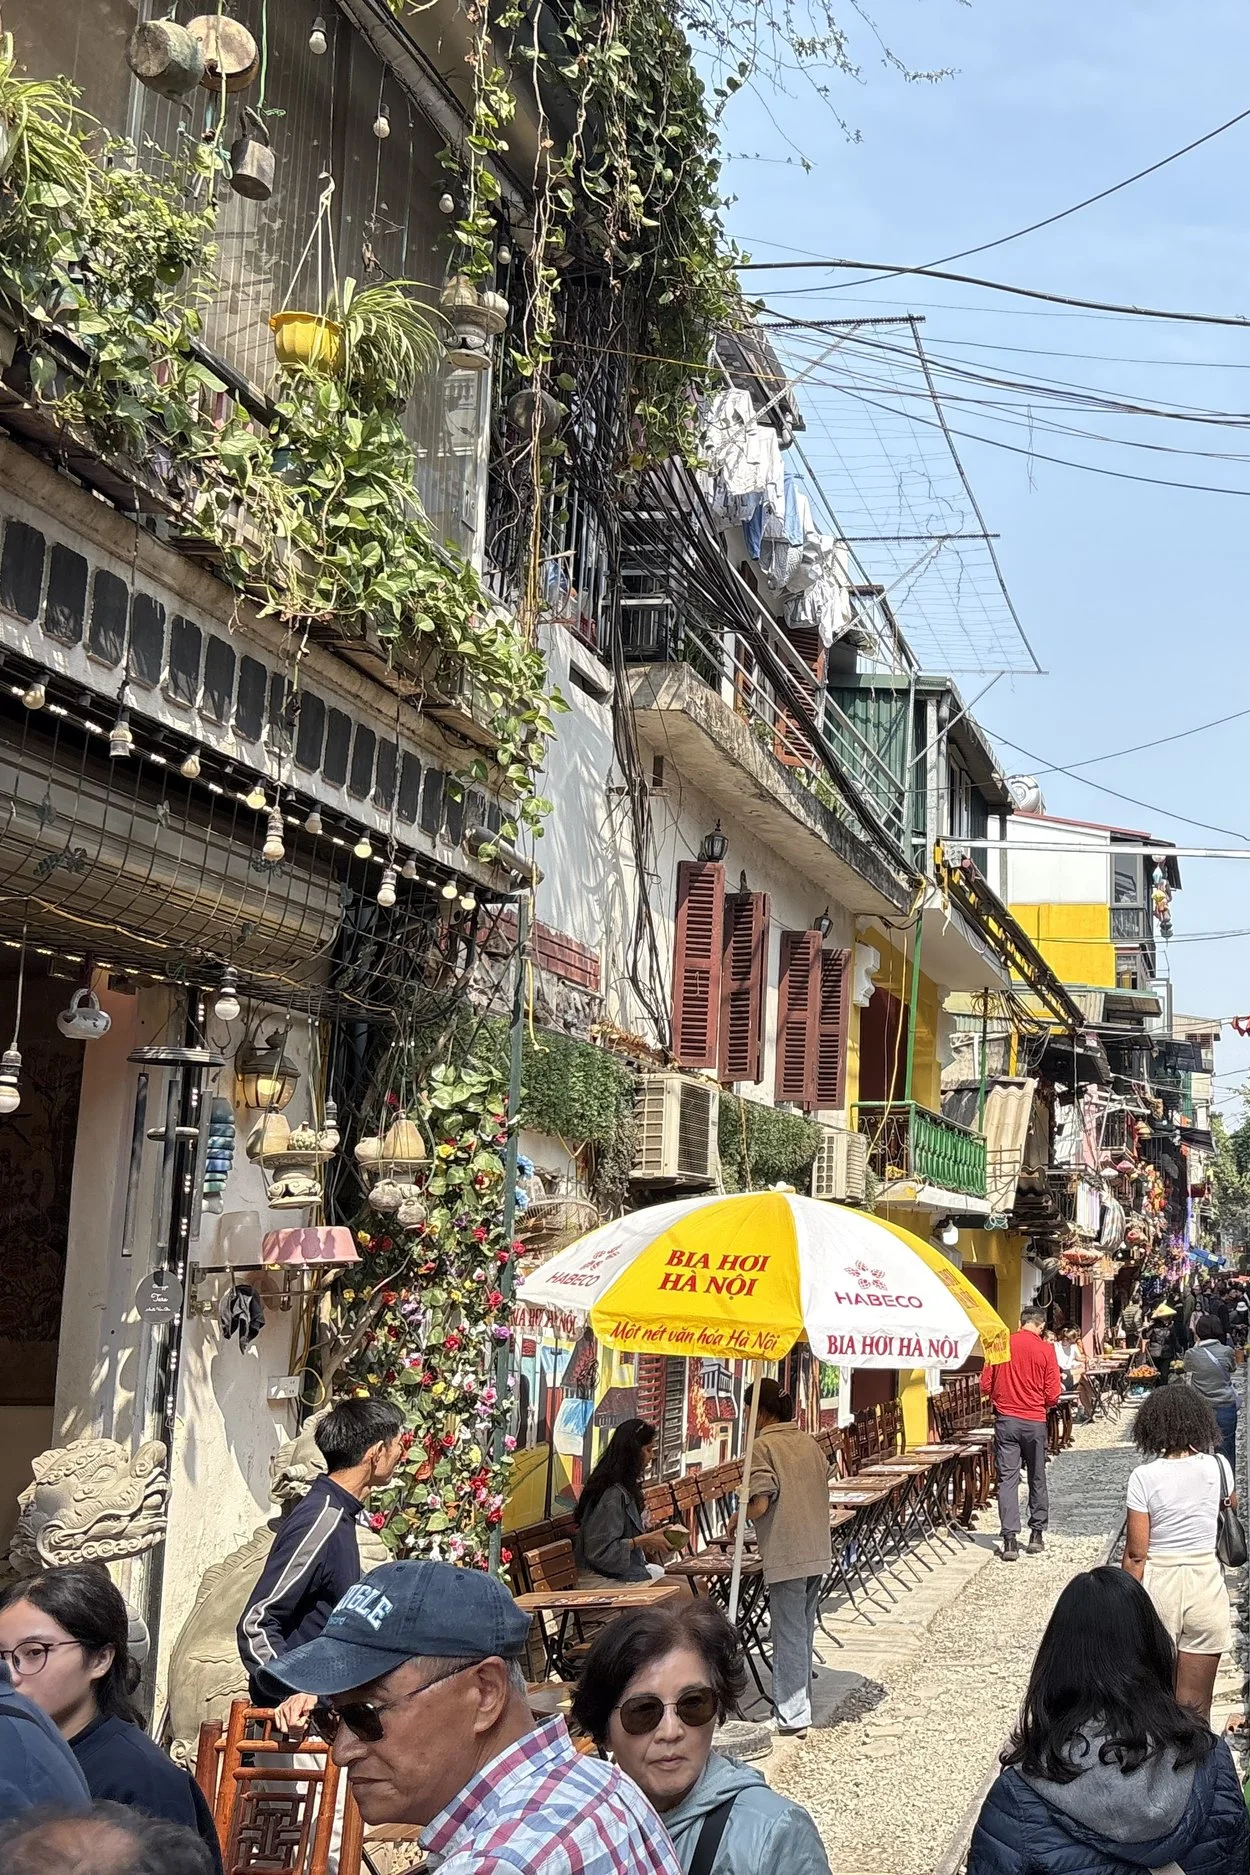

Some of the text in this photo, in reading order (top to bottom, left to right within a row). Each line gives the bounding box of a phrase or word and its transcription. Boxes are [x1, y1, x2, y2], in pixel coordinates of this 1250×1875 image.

[665, 1249, 771, 1272] BIA HƠI
[545, 1271, 600, 1287] HABECO
[657, 1270, 759, 1300] HÀ NỘI
[834, 1291, 923, 1309] HABECO
[610, 1321, 781, 1354] Một nét văn hóa Hà Nội
[826, 1334, 857, 1355] BIA
[861, 1335, 894, 1356] HƠI
[897, 1332, 924, 1357] HÀ
[928, 1335, 959, 1363] NỘI
